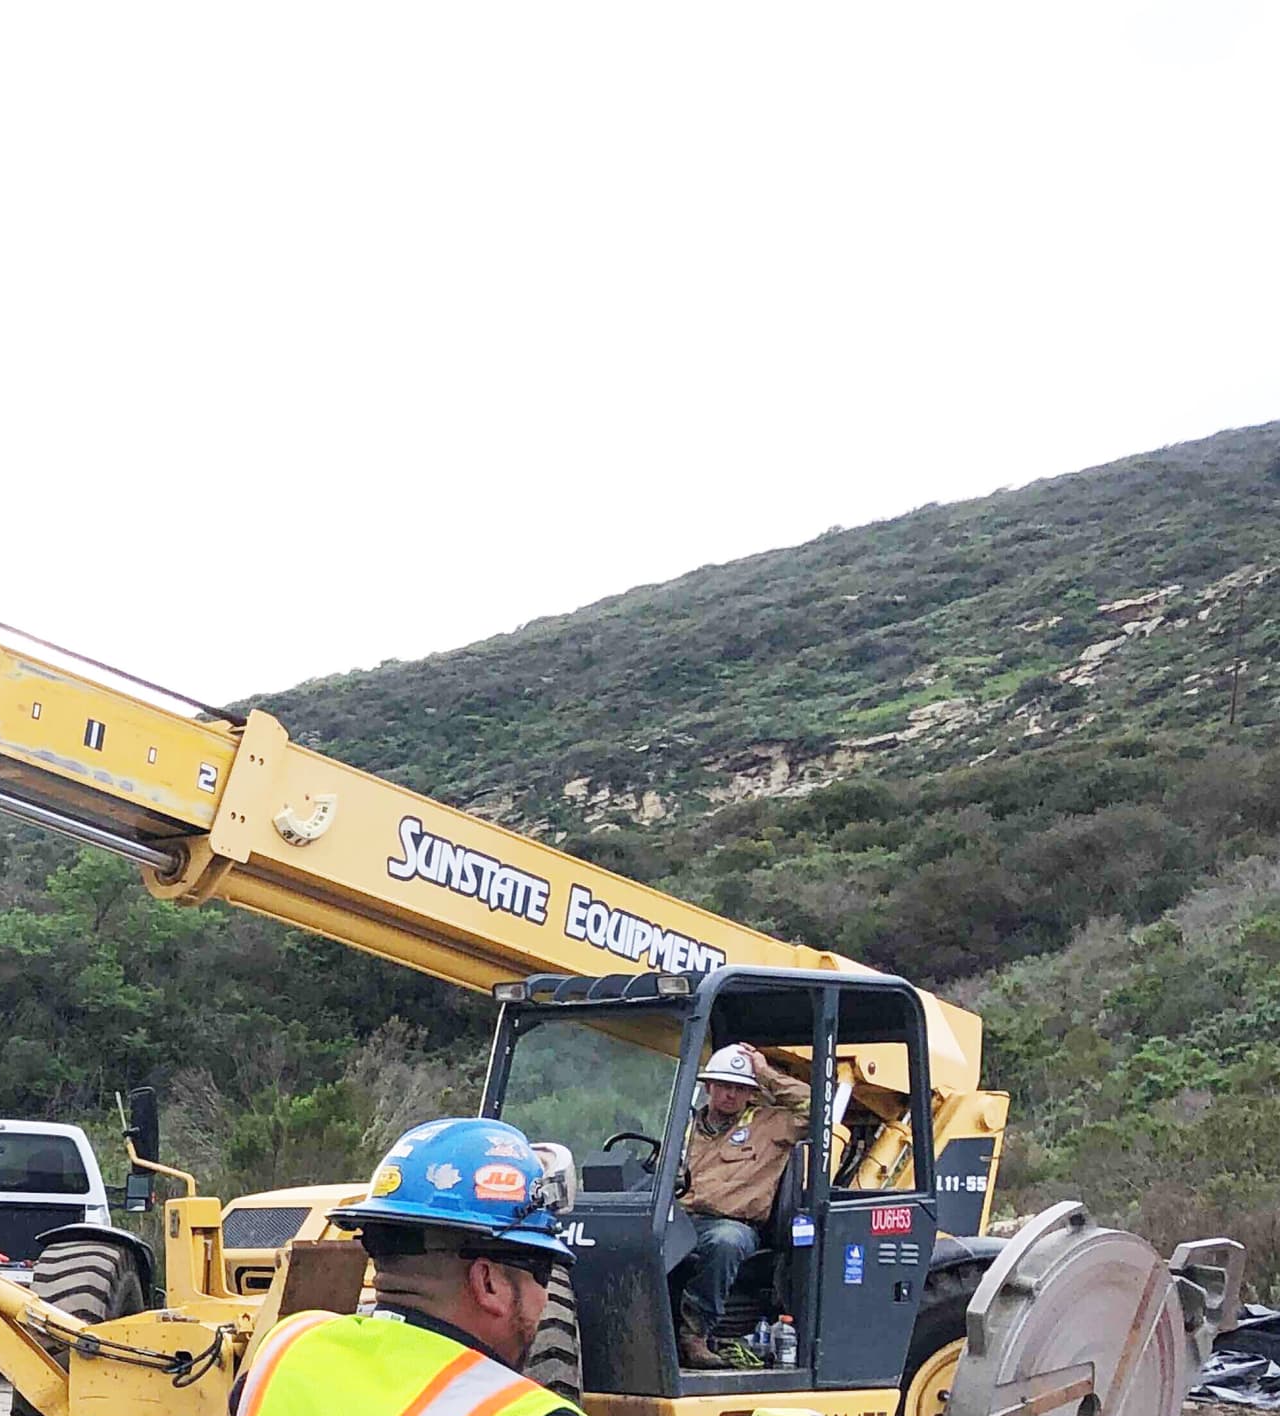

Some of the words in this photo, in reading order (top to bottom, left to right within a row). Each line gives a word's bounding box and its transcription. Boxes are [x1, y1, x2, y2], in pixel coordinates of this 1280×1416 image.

[388, 816, 550, 925] SUNSTATE
[565, 883, 726, 974] EQUIPMENT
[872, 1208, 911, 1230] UU6H53
